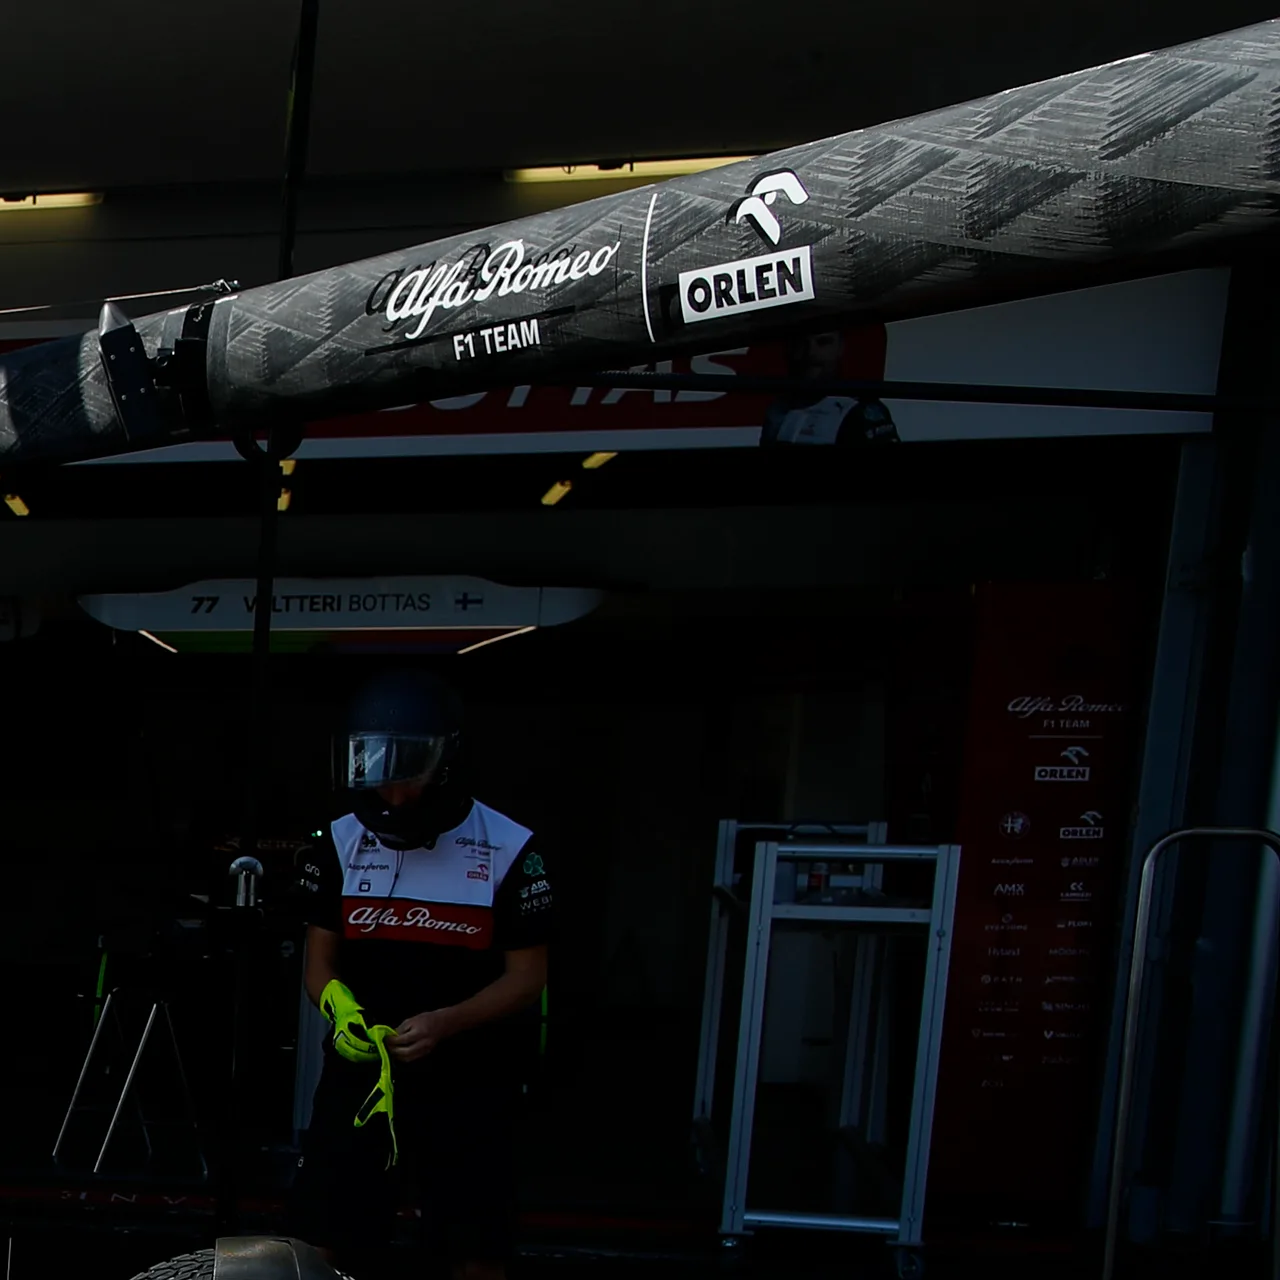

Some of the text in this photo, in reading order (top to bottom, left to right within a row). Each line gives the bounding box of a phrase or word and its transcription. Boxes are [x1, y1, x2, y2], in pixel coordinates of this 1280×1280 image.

[386, 239, 621, 339] Alfa Romeo
[687, 257, 804, 312] ORLEN
[452, 319, 540, 361] F1 TEAM
[190, 593, 432, 615] 77 VLTTERI BOTTAS
[1007, 696, 1057, 719] Alfa
[1042, 719, 1090, 729] F1 TEAM
[1037, 768, 1087, 779] ORLEN
[1062, 828, 1101, 837] ORLEN
[348, 907, 482, 935] Alfa Romeo
